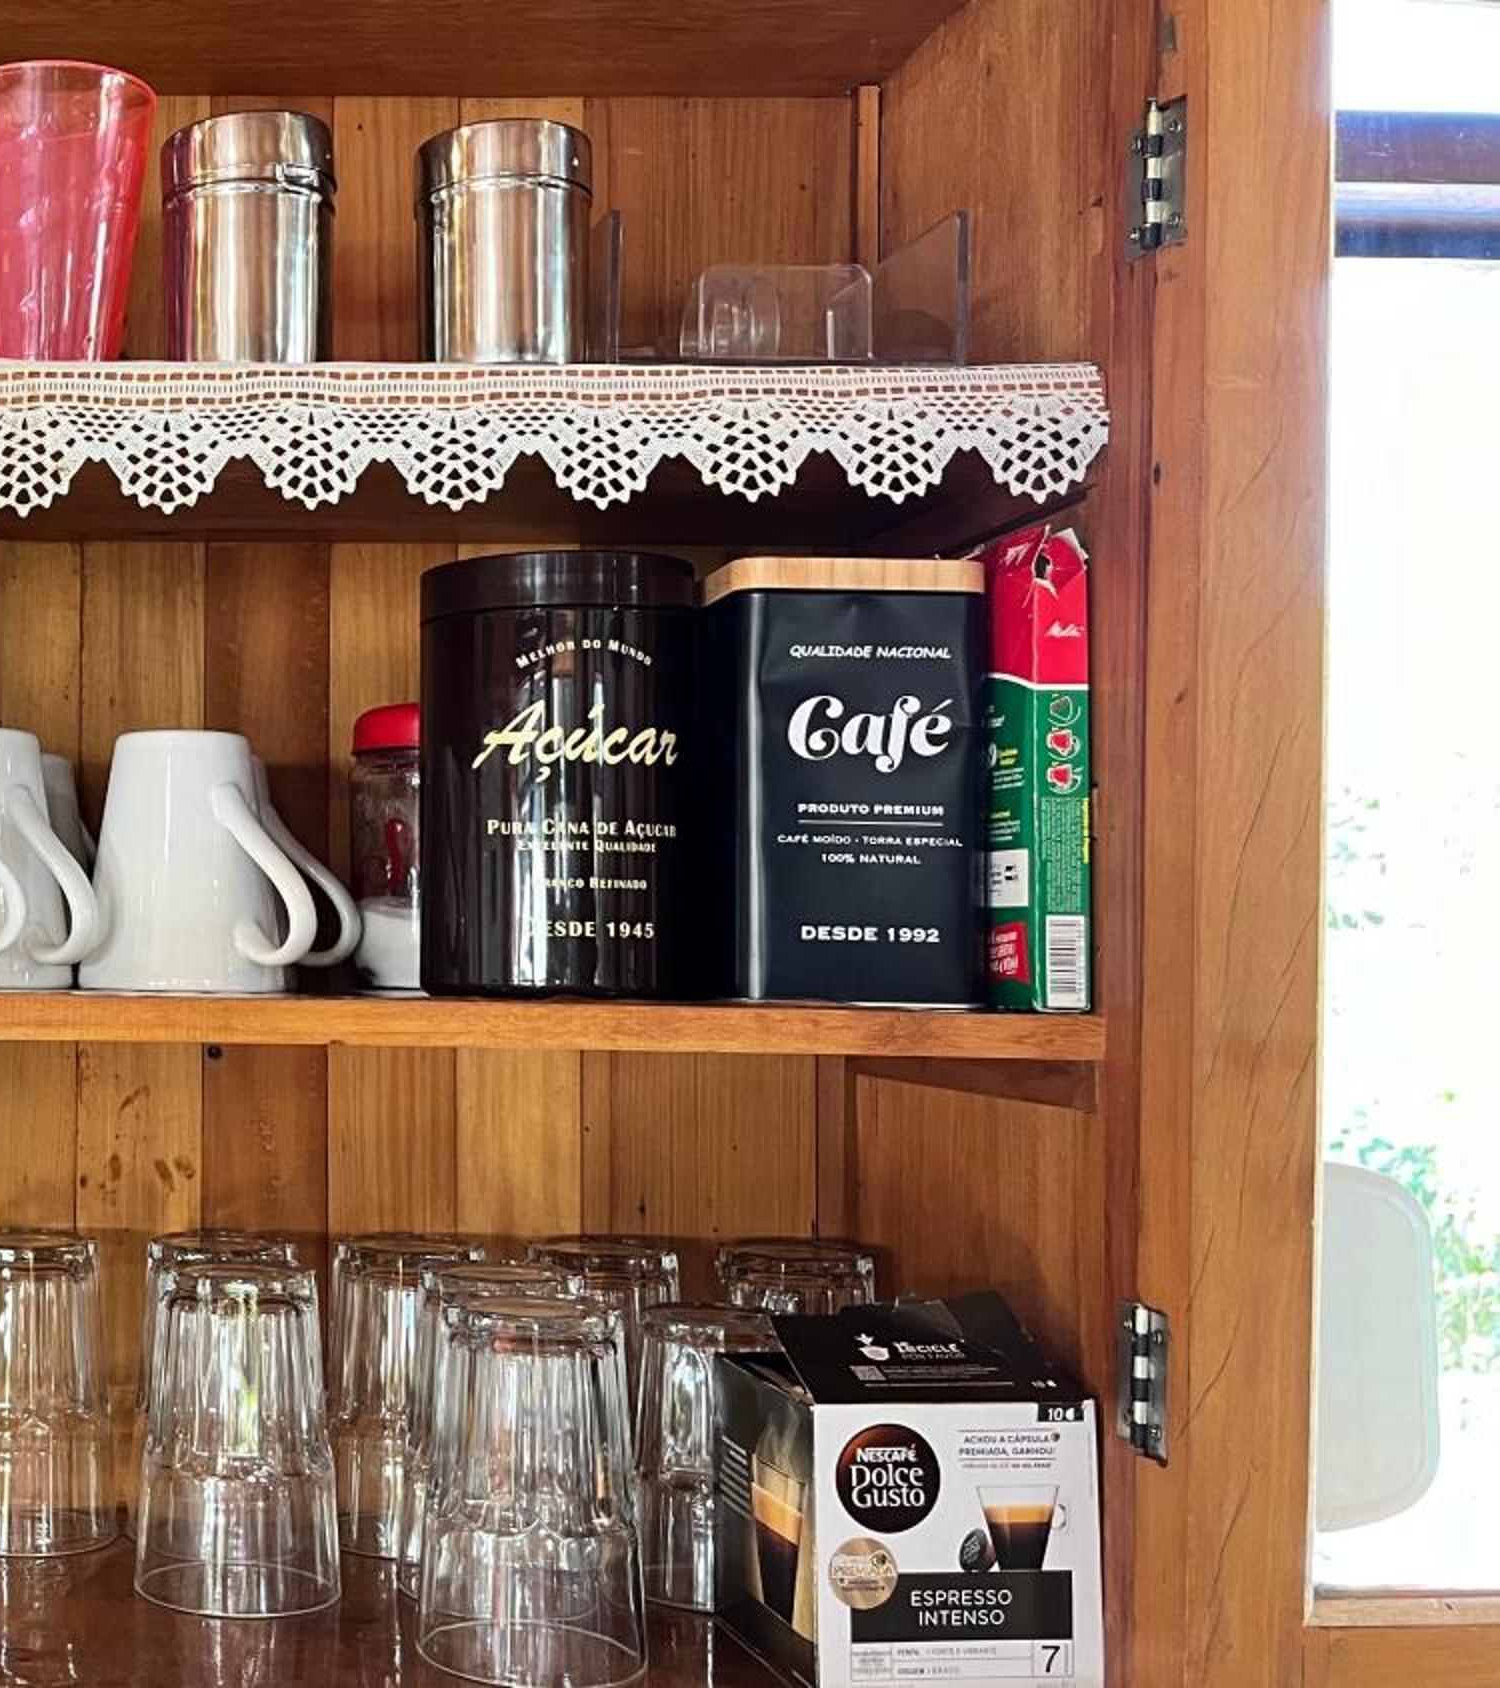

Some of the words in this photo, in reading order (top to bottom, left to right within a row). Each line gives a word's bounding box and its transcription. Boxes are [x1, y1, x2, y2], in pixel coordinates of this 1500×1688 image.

[515, 639, 575, 669] MELHOR
[582, 639, 601, 649] DO
[608, 639, 653, 667] MUNDO
[789, 645, 873, 659] QUALIDADE
[876, 646, 952, 660] NACIONAL
[471, 699, 679, 783] Açúcar
[787, 695, 954, 773] Café
[798, 803, 870, 815] PRODUTO
[874, 804, 944, 817] PREMIUM
[487, 819, 532, 835] PURA
[597, 821, 619, 836] DE
[518, 840, 589, 851] EXELENTE
[777, 834, 809, 844] CAFÉ
[813, 834, 851, 845] MOÍDO
[863, 836, 902, 846] TORRA
[906, 837, 963, 848] ESPECIAL
[822, 853, 855, 864] 100%
[860, 854, 921, 865] NATURAL
[530, 921, 596, 938] ESDE
[607, 922, 655, 939] 1945
[801, 926, 879, 941] DESDE
[888, 927, 941, 943] 1992
[1047, 1407, 1063, 1421] 10
[856, 1443, 918, 1462] NESCAFÉ
[850, 1463, 924, 1487] Dolce
[851, 1485, 925, 1508] Gusto
[911, 1589, 1013, 1607] ESPRESSO
[919, 1610, 1005, 1626] INTENSO
[1041, 1645, 1061, 1673] 7
